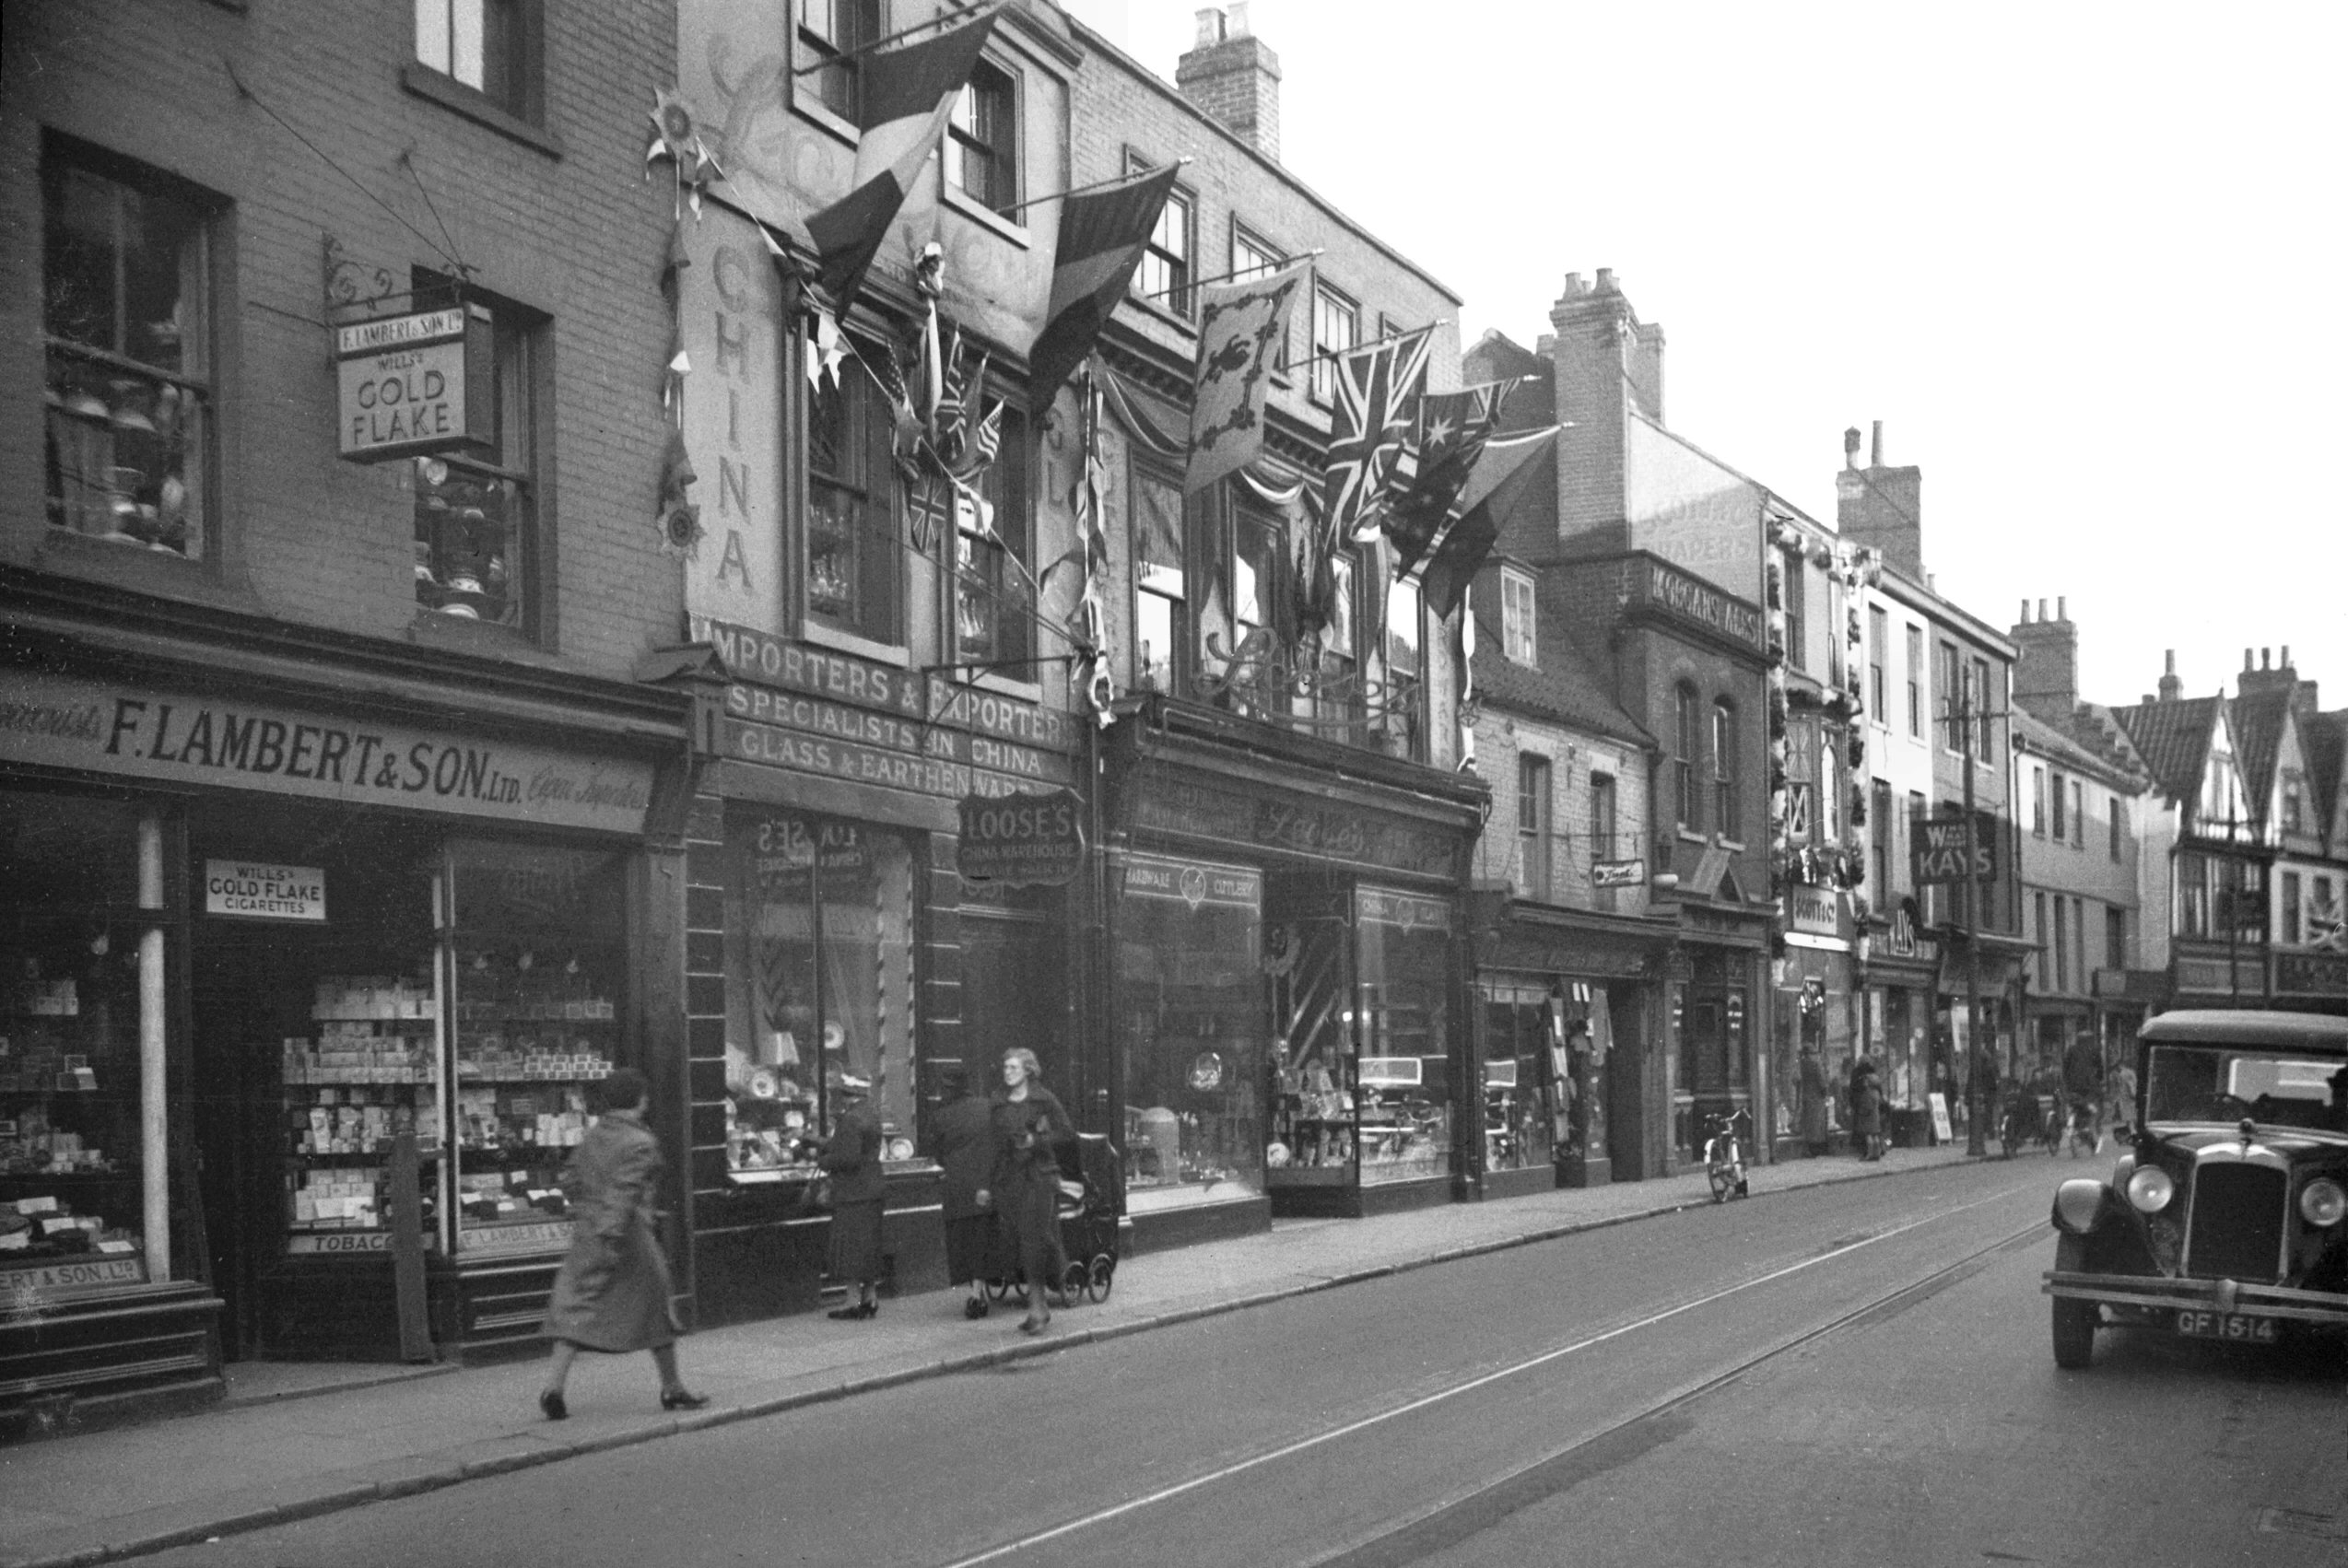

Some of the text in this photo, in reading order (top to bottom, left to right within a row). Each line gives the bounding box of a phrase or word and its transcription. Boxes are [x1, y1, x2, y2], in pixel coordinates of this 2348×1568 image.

[358, 370, 445, 409] GOLD
[354, 403, 450, 445] FLAKE
[711, 244, 754, 597] CHINA
[901, 681, 918, 711] &
[147, 704, 382, 787] LAMBERT
[374, 752, 399, 789] &
[728, 685, 1042, 776] SPECIALISTS IN CHINA
[742, 731, 828, 767] GLASS
[841, 753, 853, 775] &
[968, 803, 1071, 840] LOOSE'S
[209, 877, 321, 902] GOLD FLAKE
[225, 897, 305, 914] CIGARETTES
